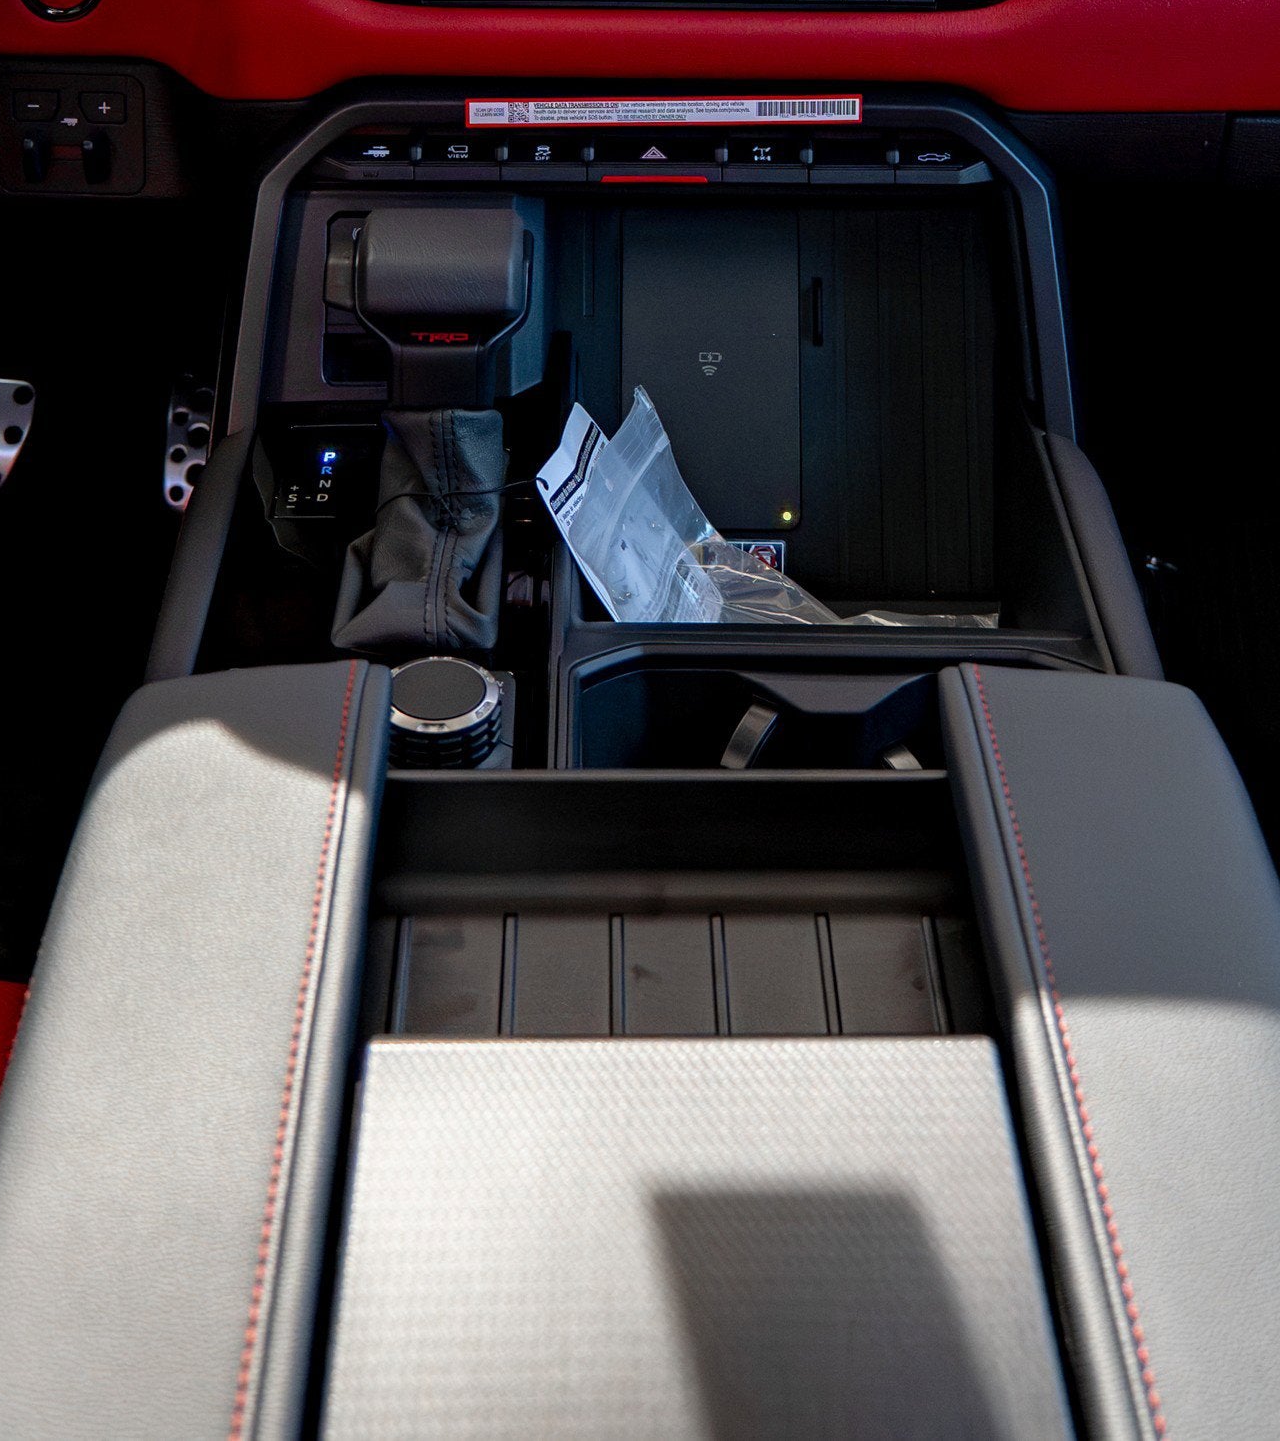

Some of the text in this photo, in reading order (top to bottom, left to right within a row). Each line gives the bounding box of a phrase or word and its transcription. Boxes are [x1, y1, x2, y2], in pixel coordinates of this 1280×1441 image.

[410, 332, 469, 343] TRD
[323, 451, 336, 462] P
[321, 466, 332, 475] R
[319, 479, 332, 488] N
[287, 493, 298, 502] S
[316, 493, 329, 502] D
